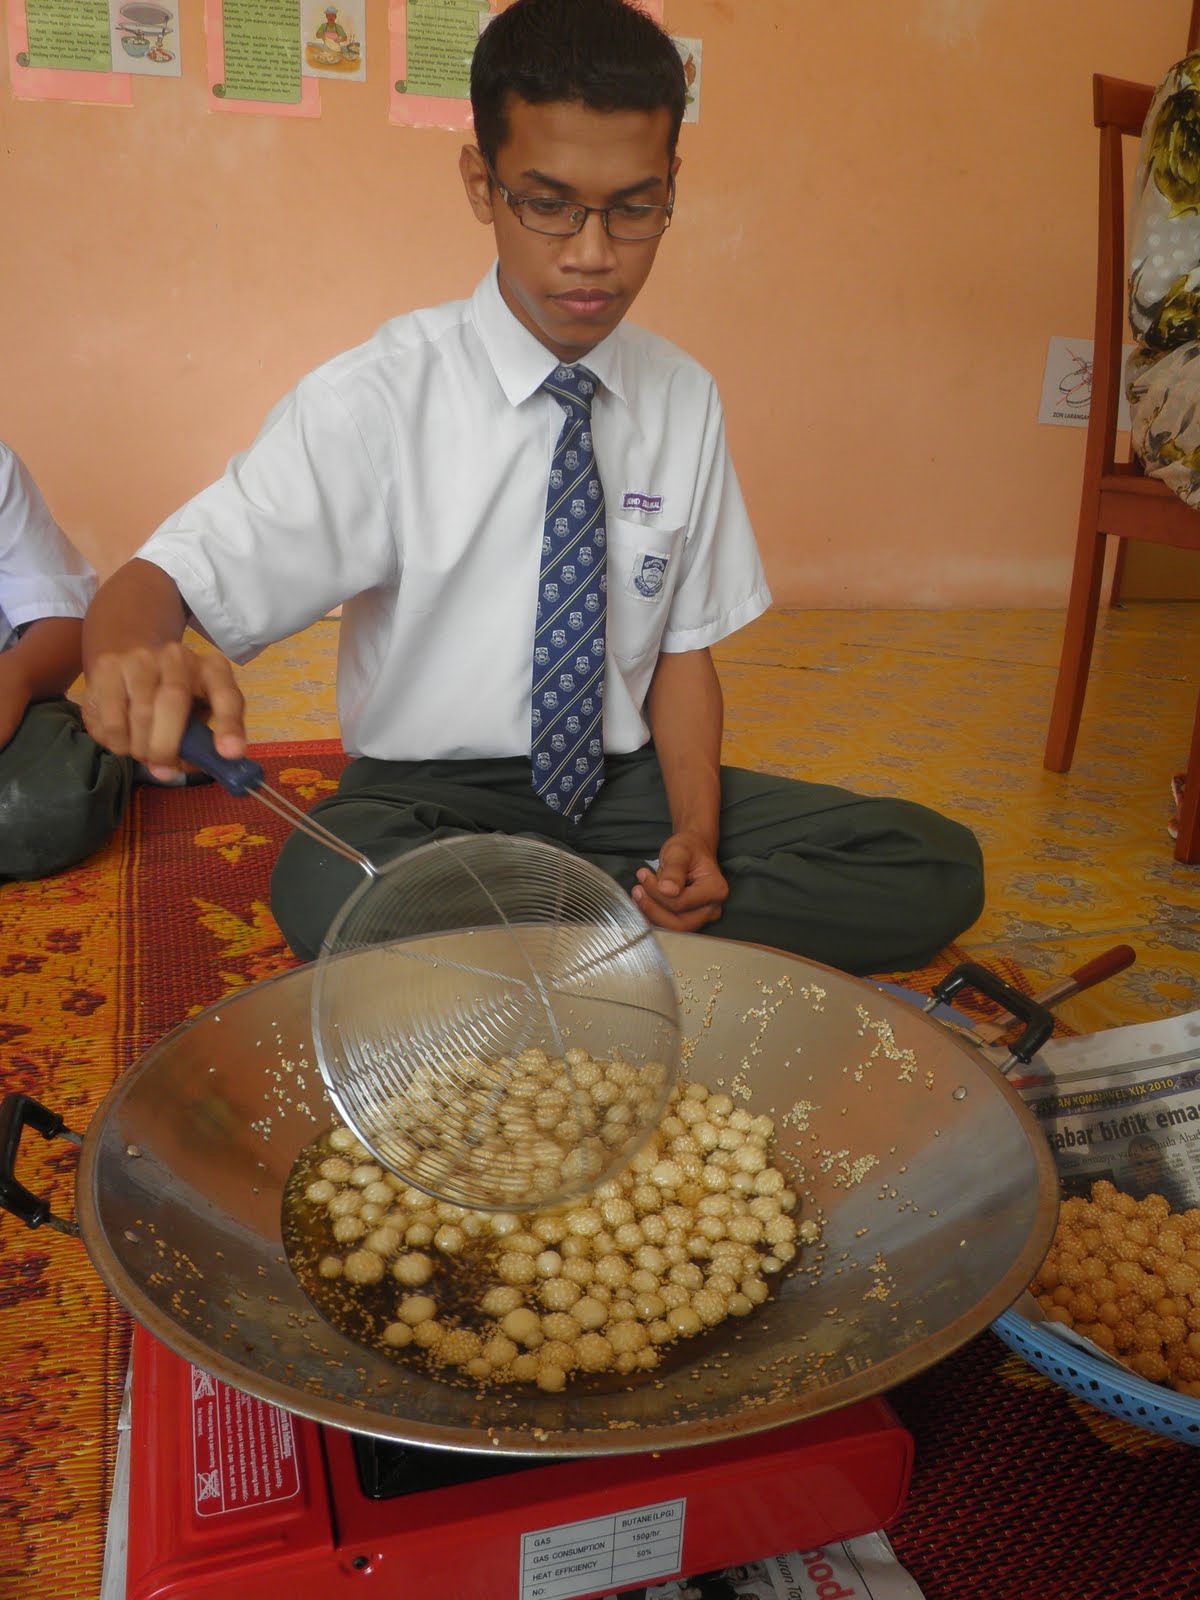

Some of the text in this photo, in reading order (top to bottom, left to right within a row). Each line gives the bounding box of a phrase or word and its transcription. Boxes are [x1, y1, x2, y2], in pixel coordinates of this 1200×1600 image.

[1064, 412, 1090, 420] LARANGA
[1128, 1084, 1147, 1096] XIX
[1148, 1078, 1174, 1092] 2010
[1099, 1113, 1151, 1141] bidik
[622, 1509, 675, 1527] BUTANE(LPG)
[534, 1537, 551, 1547] GAS
[632, 1530, 660, 1542] 150g/hr
[533, 1541, 605, 1564] GAS CONSUMPTION
[637, 1549, 652, 1558] 50%
[532, 1560, 598, 1581] HEAT EFFICIENCY
